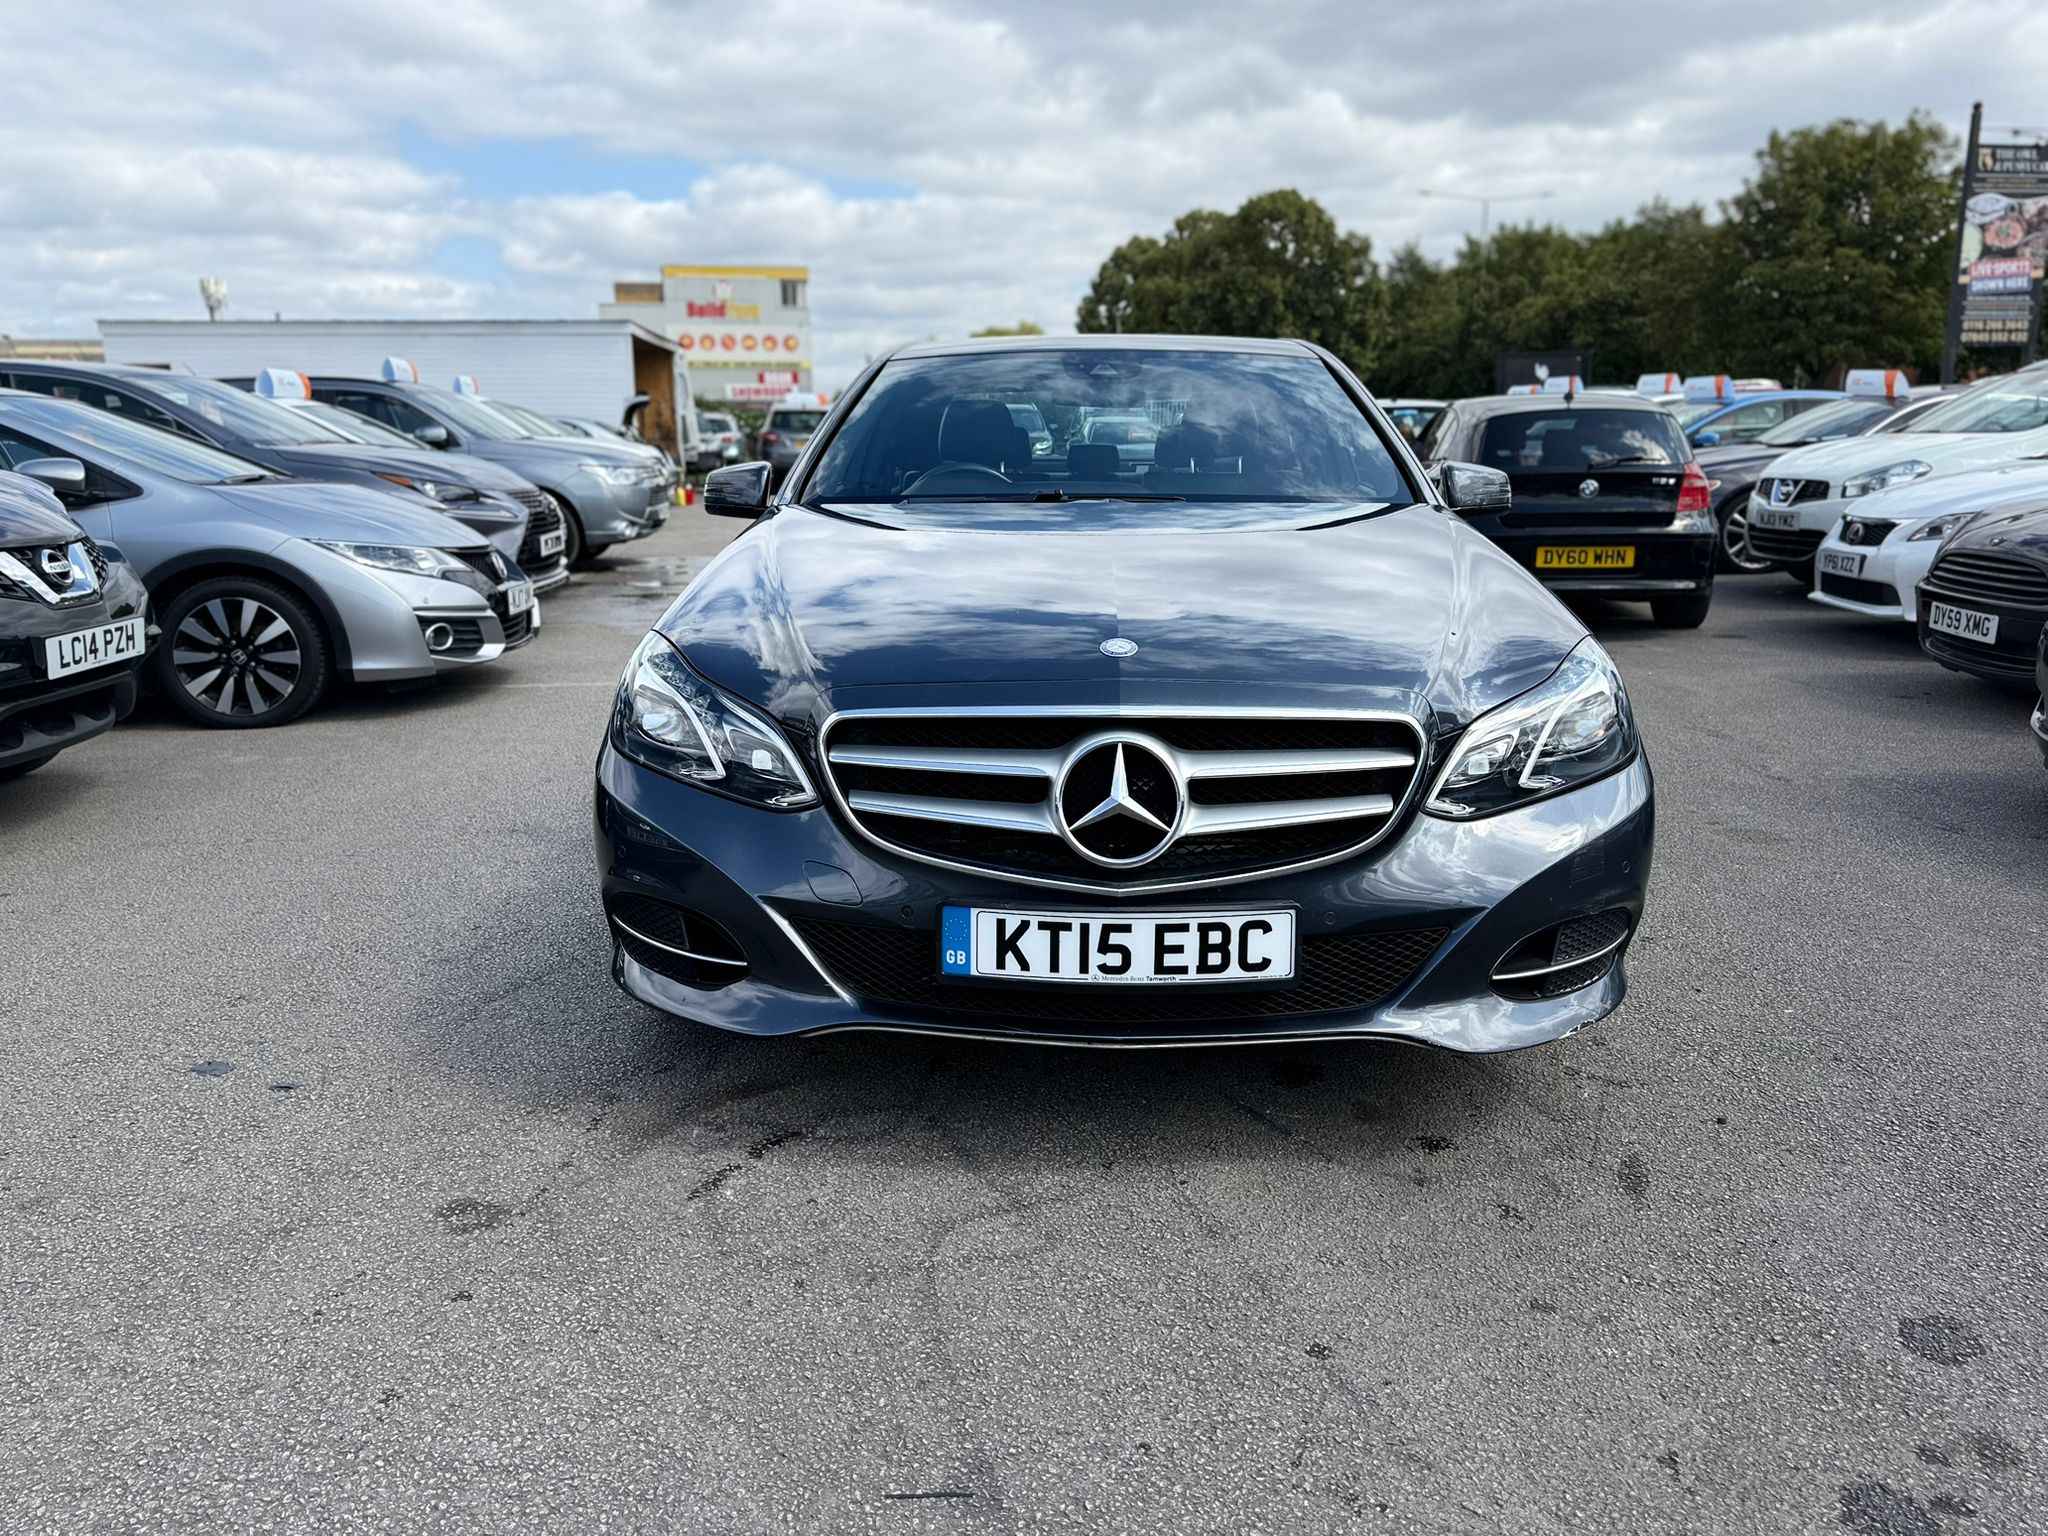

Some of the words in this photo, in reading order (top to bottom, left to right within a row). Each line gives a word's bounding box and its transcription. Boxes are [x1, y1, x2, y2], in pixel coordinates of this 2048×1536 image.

[1543, 549, 1589, 565] DY60
[1594, 549, 1626, 565] WHN
[1933, 605, 1962, 630] DY59
[1963, 612, 1991, 637] XMG
[58, 631, 99, 669] LC14
[102, 622, 136, 658] PZH
[946, 950, 966, 965] GB
[995, 918, 1132, 976] KT15
[1154, 919, 1273, 976] EBC
